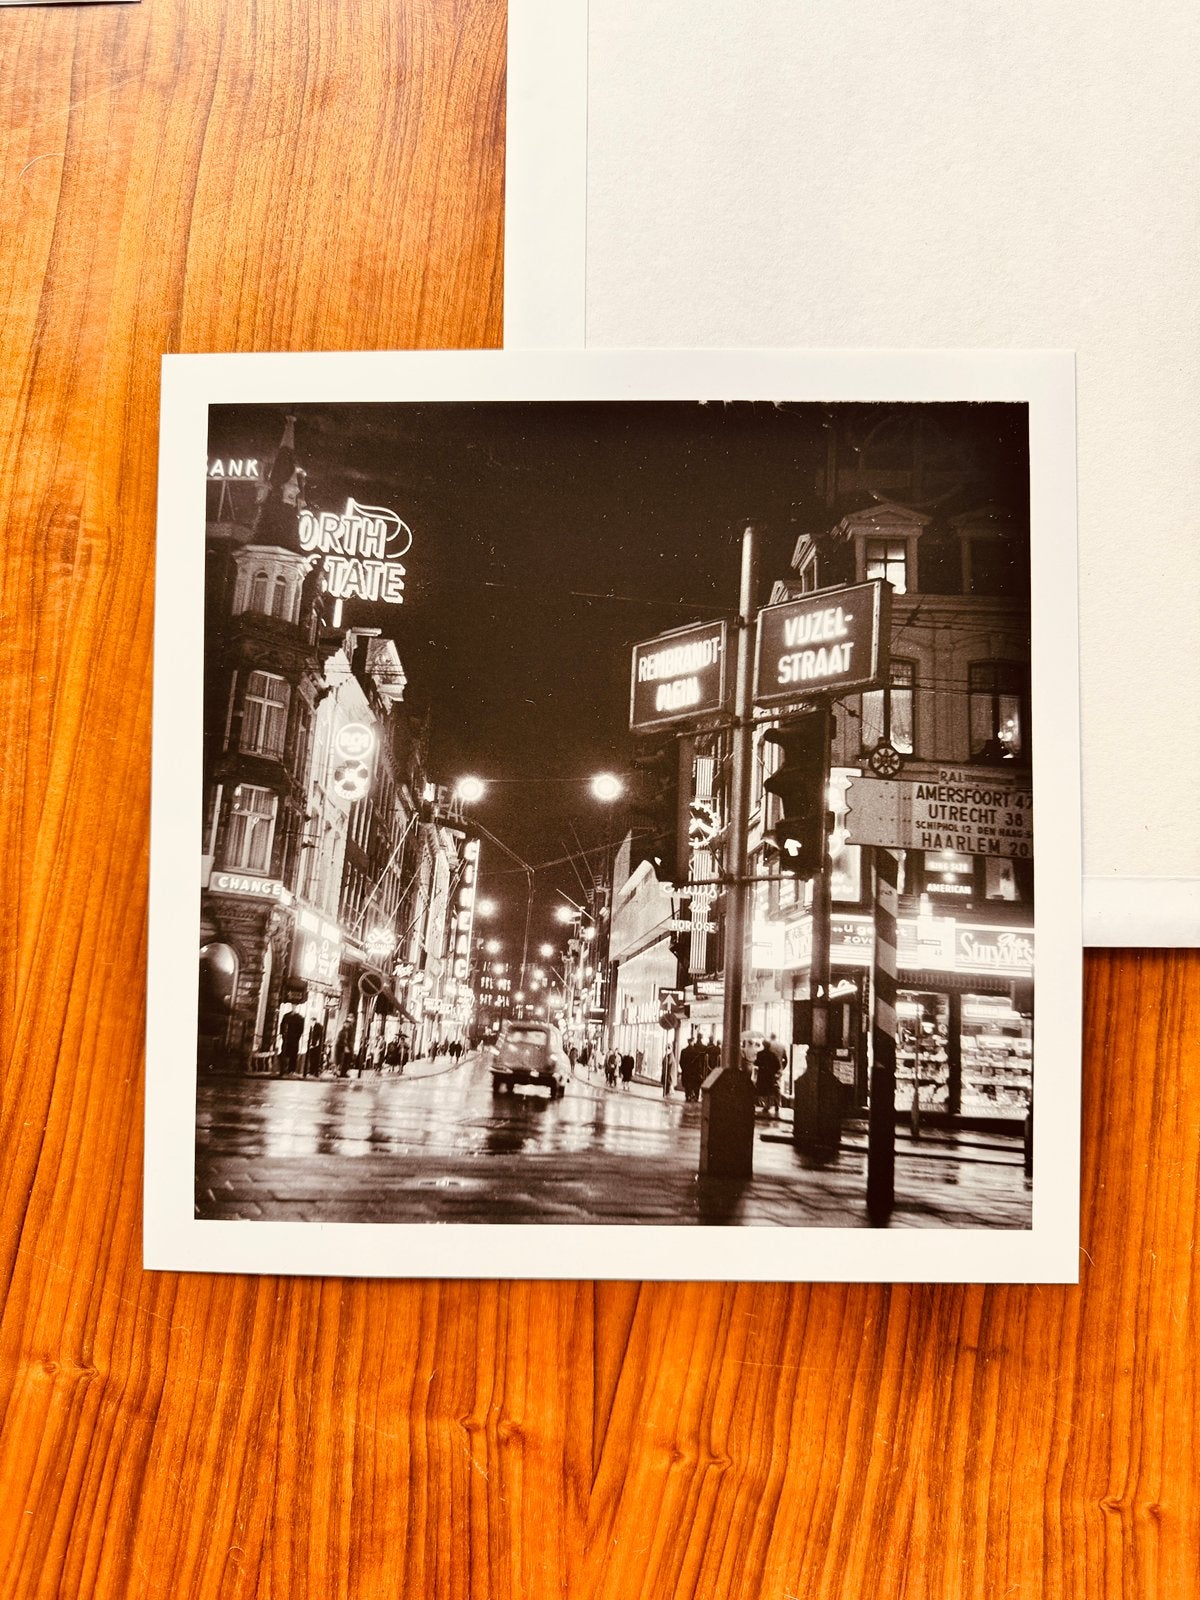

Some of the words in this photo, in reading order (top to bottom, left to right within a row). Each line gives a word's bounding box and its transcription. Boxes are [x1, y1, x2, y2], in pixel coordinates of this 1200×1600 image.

[207, 459, 259, 477] ANK
[777, 643, 854, 684] STRAAT
[656, 678, 700, 712] PLEIN
[916, 785, 1009, 808] AMERSFOORT
[928, 804, 998, 825] UTRECHT
[1005, 812, 1023, 828] 38
[915, 821, 959, 833] SCHIPHOL
[961, 825, 972, 834] 12
[978, 826, 996, 836] DEN
[921, 832, 1000, 853] HAARLEM
[1009, 841, 1029, 857] 20
[217, 876, 281, 896] CHANGE
[926, 883, 972, 895] AMERICAN
[453, 841, 478, 978] CINEAC
[671, 919, 717, 933] HORLOGE
